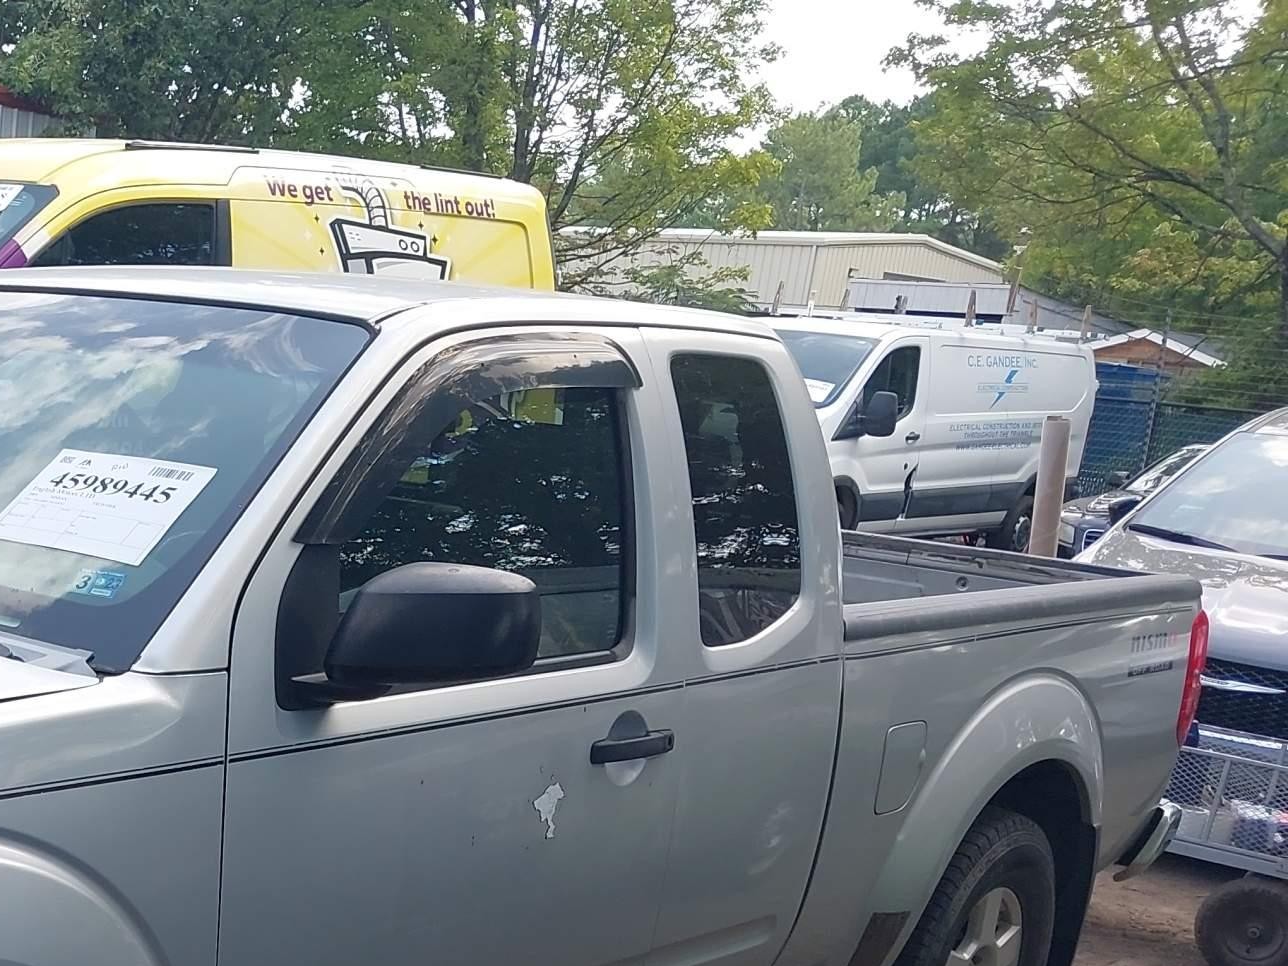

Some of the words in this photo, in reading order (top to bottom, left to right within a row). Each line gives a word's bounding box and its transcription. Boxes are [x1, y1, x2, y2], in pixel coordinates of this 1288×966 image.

[267, 179, 298, 198] We
[303, 182, 334, 206] get
[404, 190, 432, 212] the
[434, 192, 462, 214] lint
[465, 198, 496, 218] out!
[967, 355, 985, 368] C.E.
[50, 471, 178, 504] 45989445
[75, 574, 92, 590] 3
